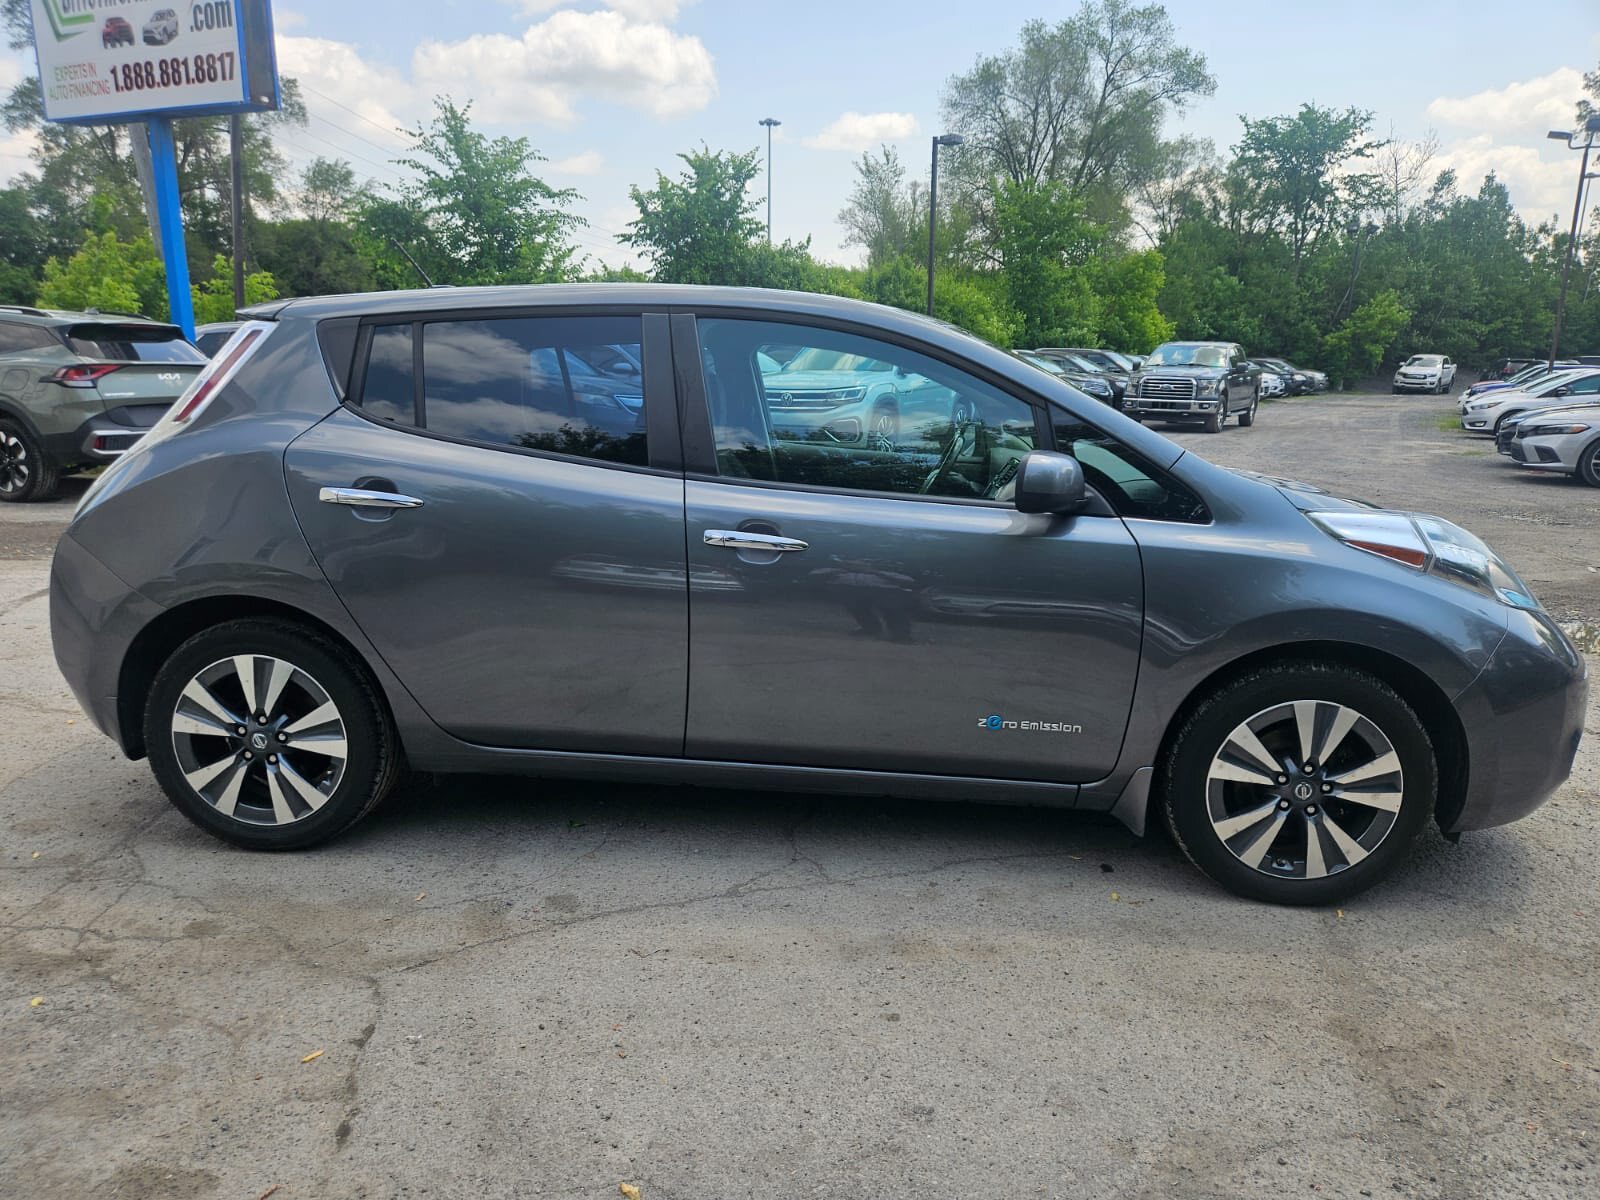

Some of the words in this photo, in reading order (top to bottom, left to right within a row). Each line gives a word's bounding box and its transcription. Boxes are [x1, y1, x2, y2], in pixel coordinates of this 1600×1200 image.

[190, 0, 233, 32] .com
[55, 63, 89, 81] EXPERTS
[88, 62, 97, 77] IN
[110, 51, 235, 93] 1.888.881.8817
[49, 83, 70, 100] AUTO
[70, 79, 111, 99] FINANCING
[1020, 720, 1083, 733] Emission
